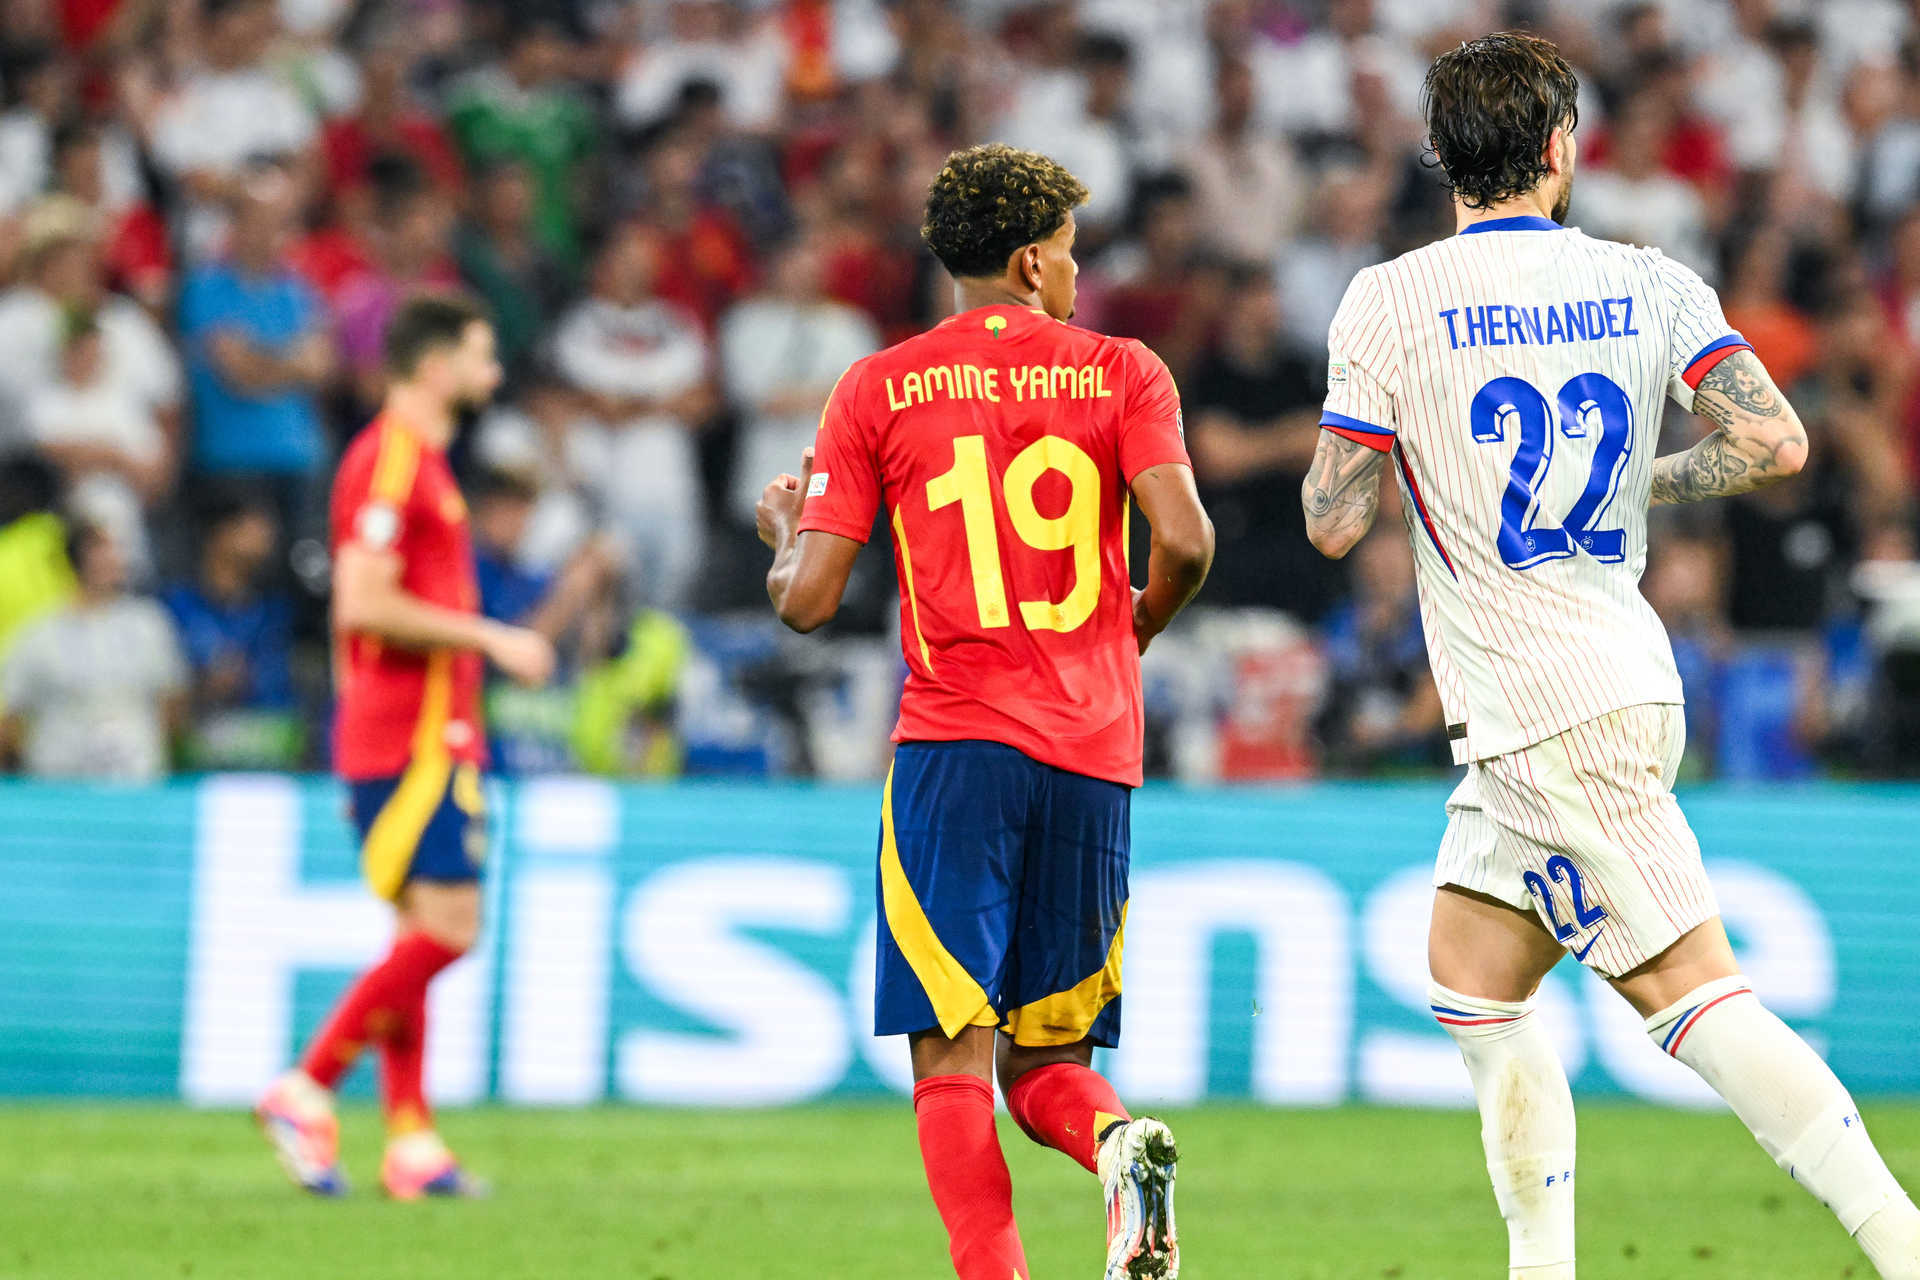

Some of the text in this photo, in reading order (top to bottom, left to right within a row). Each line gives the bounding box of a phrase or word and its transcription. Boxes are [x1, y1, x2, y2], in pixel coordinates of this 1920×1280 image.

[1440, 296, 1639, 349] T.HERNANDEZ
[885, 364, 1112, 411] LAMINE YAMAL
[1470, 372, 1635, 571] 22
[926, 434, 1101, 633] 19
[1523, 855, 1608, 943] 22
